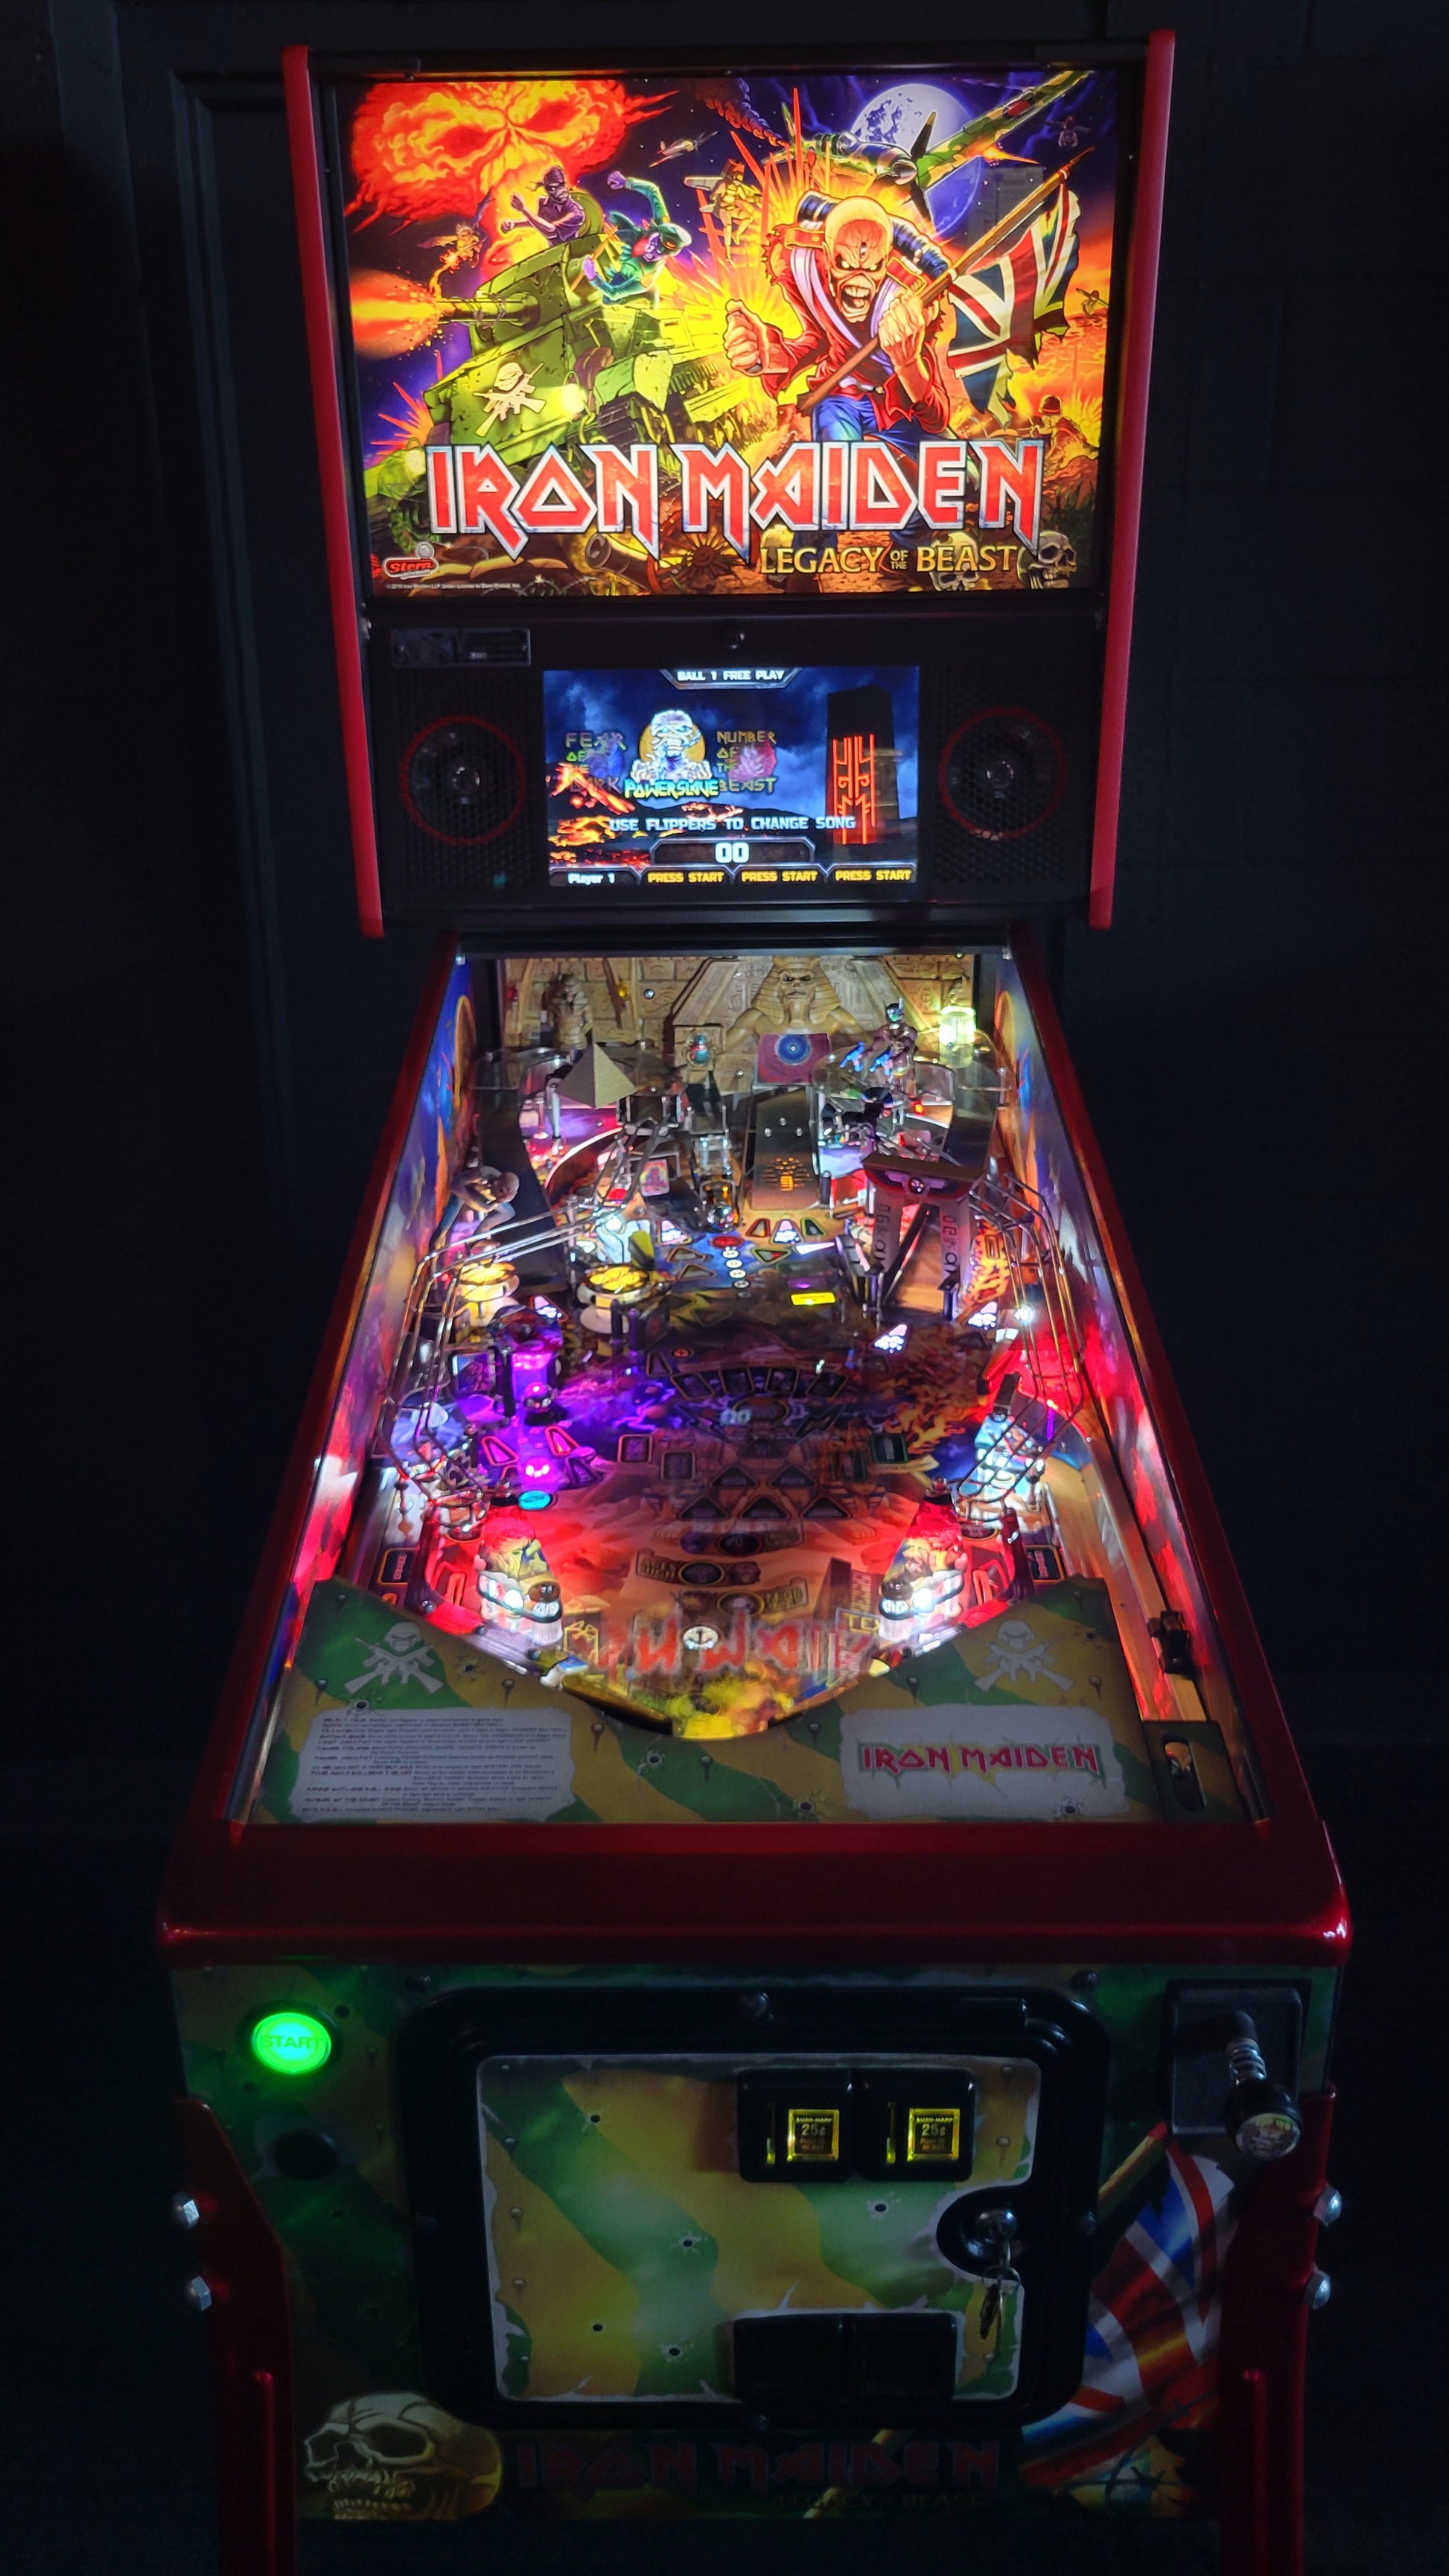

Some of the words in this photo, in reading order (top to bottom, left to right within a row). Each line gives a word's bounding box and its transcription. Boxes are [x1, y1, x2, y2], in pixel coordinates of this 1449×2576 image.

[424, 441, 660, 561] IRON
[669, 438, 1045, 564] MAIDEN
[759, 546, 885, 573] LEGACY
[890, 549, 909, 561] OF
[917, 545, 1018, 573] BEAST
[390, 561, 431, 573] Stern
[891, 561, 907, 570] THE
[677, 671, 706, 680] BALL
[710, 671, 717, 680] 1
[723, 670, 751, 680] FREE
[755, 670, 785, 680] PLAY
[716, 731, 777, 745] NUMBER
[565, 750, 587, 762] OF
[716, 747, 739, 759] OF
[624, 779, 720, 799] POWERSLAVE
[719, 777, 777, 792] BEAST
[610, 819, 638, 831] USE
[646, 818, 716, 831] FLIPPERS
[724, 817, 744, 830] TO
[751, 817, 809, 829] CHANGE
[815, 816, 856, 829] SONG
[715, 842, 749, 863] 00
[567, 873, 604, 885] Player
[608, 873, 615, 884] 1
[648, 872, 684, 883] PRESS
[688, 871, 725, 883] START
[742, 871, 778, 881] PRESS
[782, 870, 818, 881] START
[835, 870, 872, 881] PRESS
[876, 870, 912, 880] START
[862, 1745, 952, 1775] IRON
[958, 1744, 1100, 1775] MAIDEN
[261, 2035, 323, 2050] START
[518, 2440, 698, 2503] IRON
[711, 2440, 1001, 2499] MAIDEN
